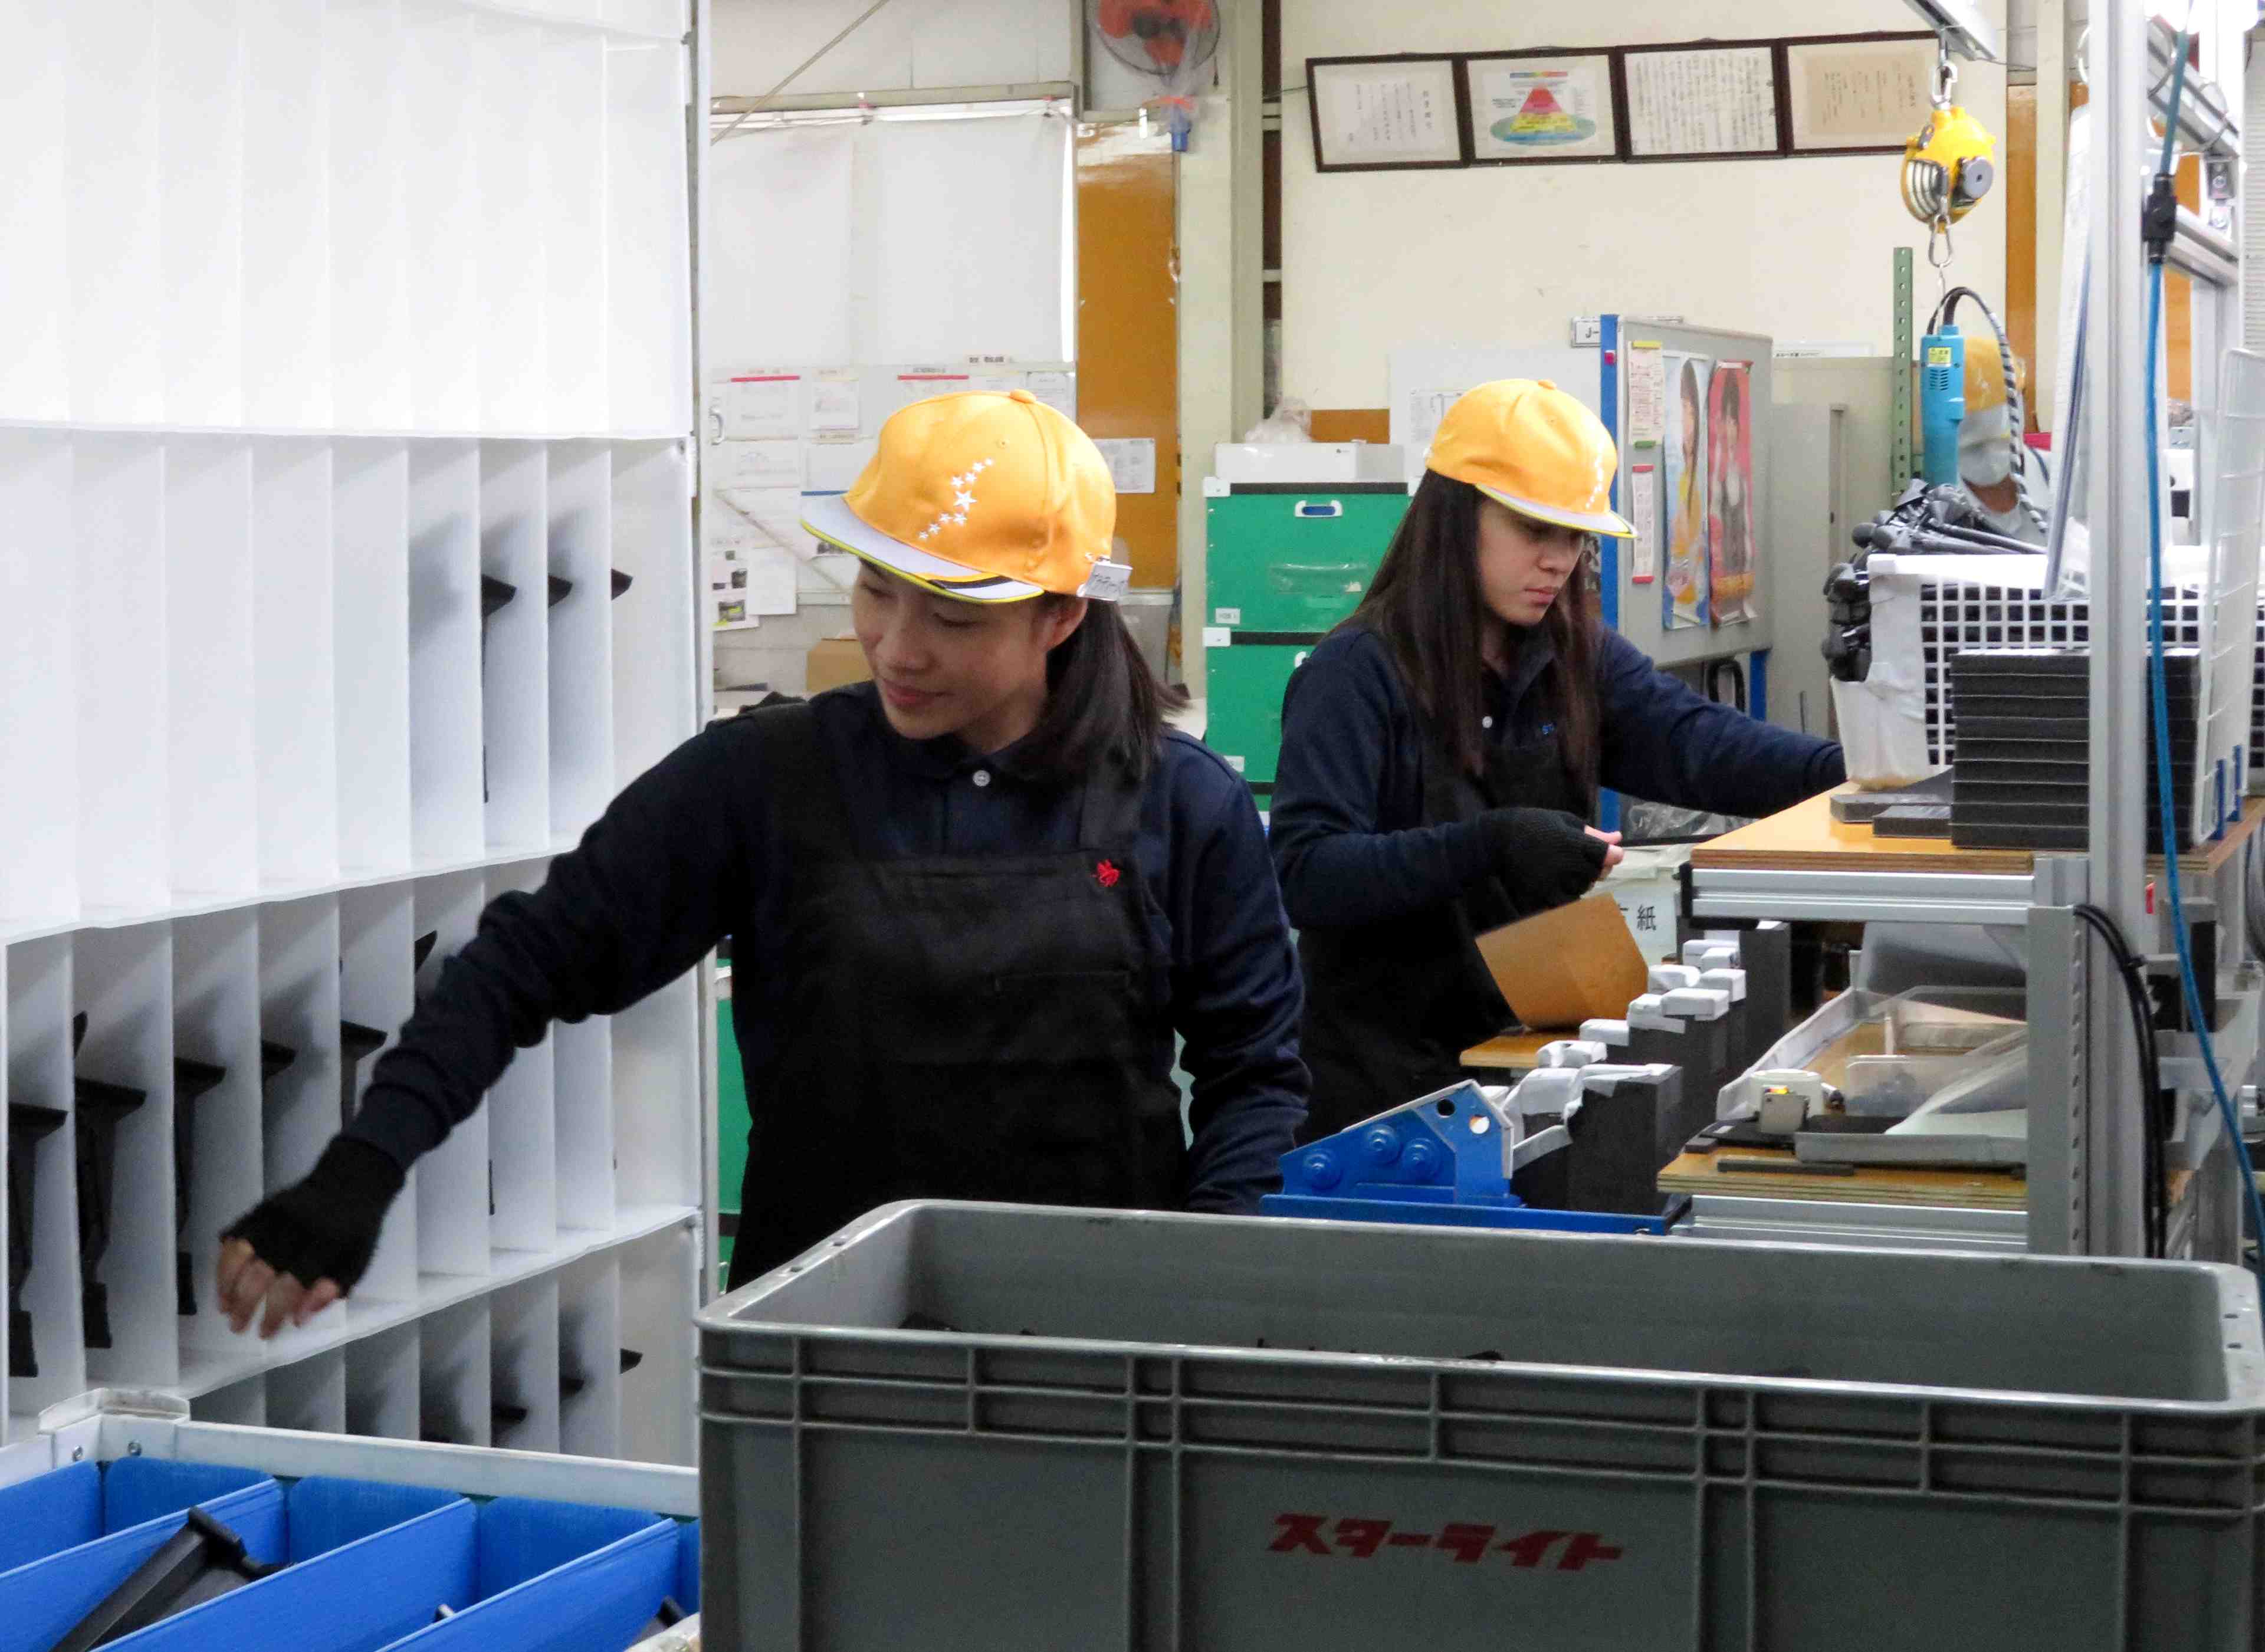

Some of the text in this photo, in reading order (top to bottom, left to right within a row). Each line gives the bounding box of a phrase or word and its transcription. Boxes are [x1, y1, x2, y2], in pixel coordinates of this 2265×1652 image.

[1268, 1513, 1624, 1571] スターライト
